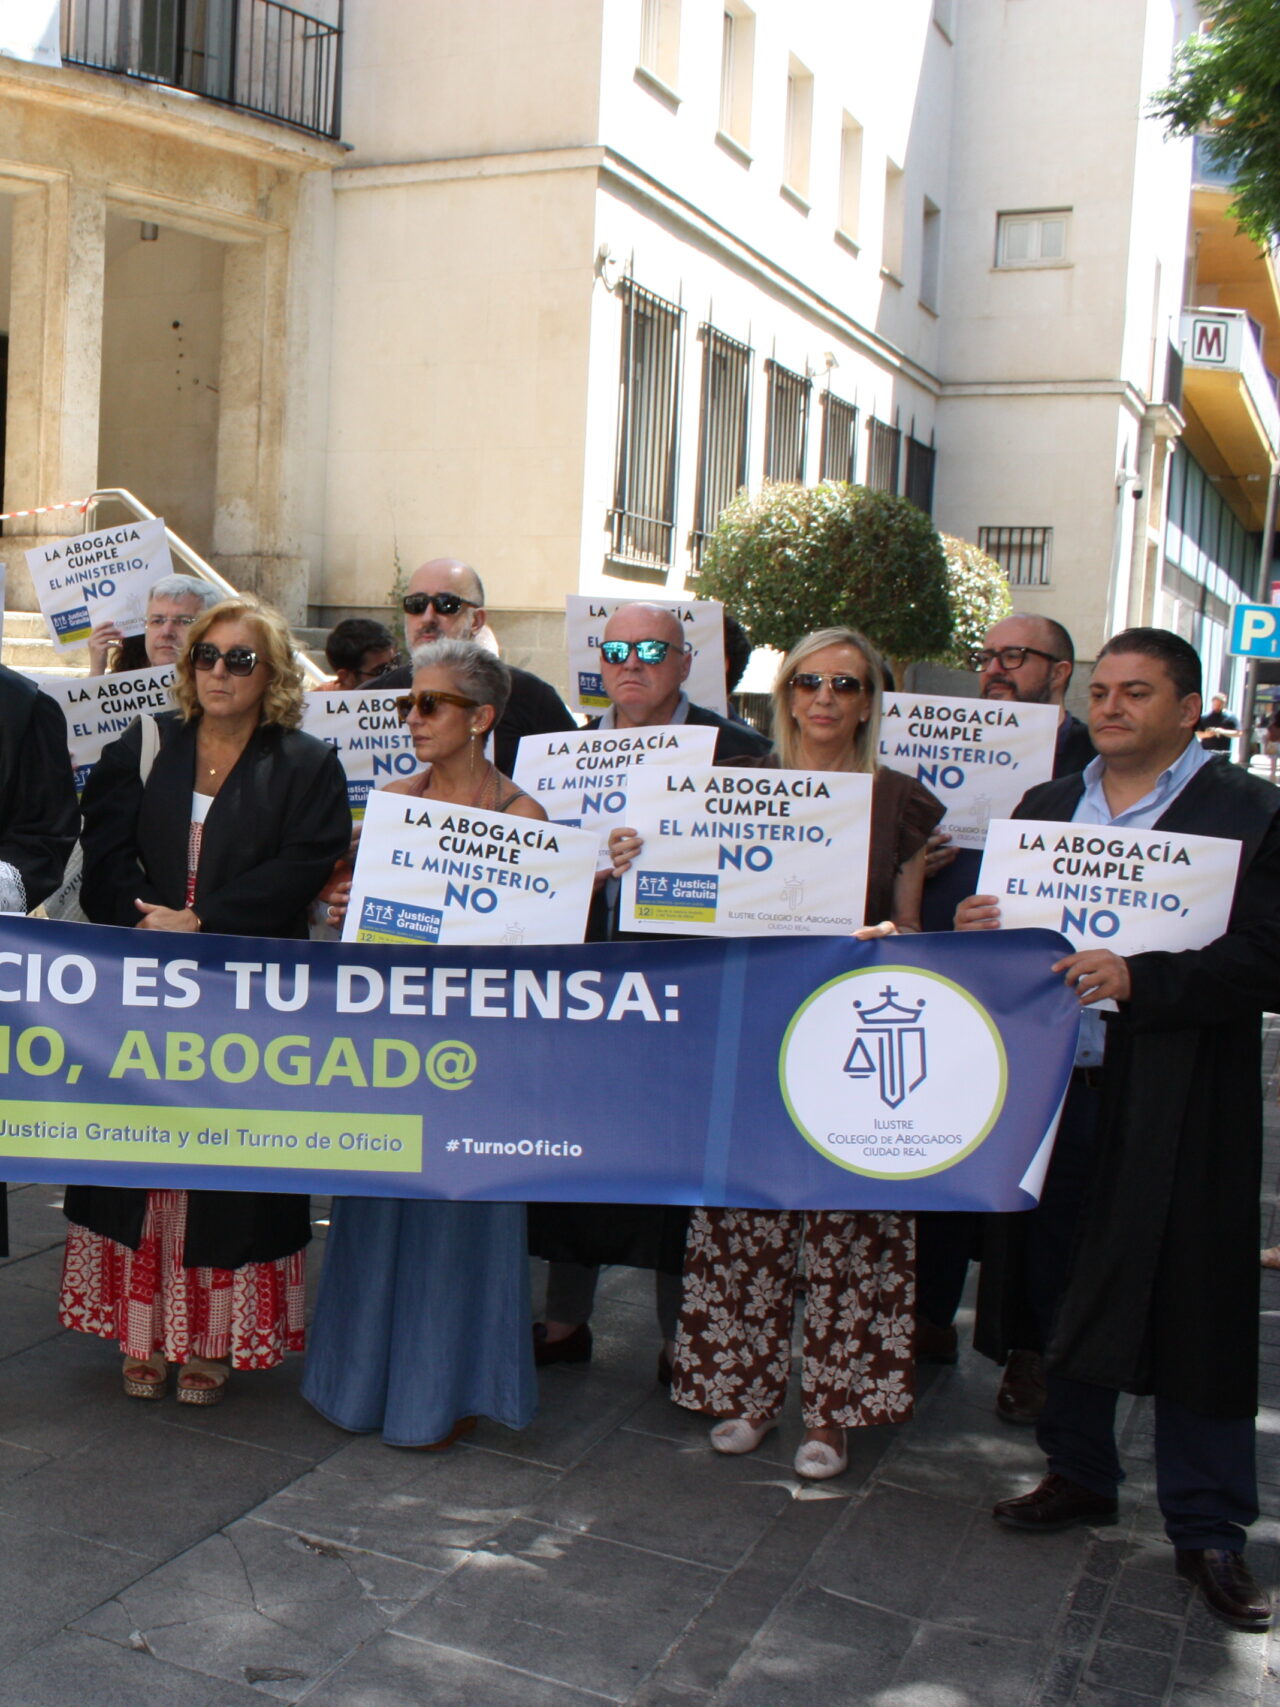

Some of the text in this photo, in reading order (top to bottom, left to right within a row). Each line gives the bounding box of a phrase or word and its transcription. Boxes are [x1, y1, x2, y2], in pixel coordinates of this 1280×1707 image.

[1196, 326, 1222, 358] M
[44, 529, 141, 562] LA ABOGACÍA
[67, 547, 119, 569] CUMPLE
[49, 558, 149, 590] EL MINISTERIO,
[82, 578, 116, 602] NO
[589, 605, 608, 618] LA
[1240, 609, 1276, 651] P
[68, 671, 175, 703] LA ABOGACÍ
[101, 693, 166, 714] CUMPLE
[326, 701, 350, 714] LA
[881, 703, 1019, 727] A ABOGACÍA
[73, 723, 92, 737] EL
[908, 723, 983, 742] CUMPLE
[547, 732, 679, 756] LA ABOGACÍA
[879, 741, 1019, 770] L MINISTERIO,
[372, 753, 417, 776] NO
[918, 763, 965, 789] NO
[537, 778, 556, 791] EL
[667, 775, 831, 799] LA ABOGACÍA
[581, 791, 626, 815] NO
[705, 798, 791, 817] CUMPLE
[404, 808, 560, 853] LA ABOGACÍA
[659, 819, 833, 847] EL MINISTERIO,
[439, 836, 520, 865] CUMPLE
[718, 844, 773, 872] NO
[1020, 833, 1191, 865] LA ABOGACÍA
[391, 850, 557, 899] EL MINISTERIO,
[1053, 858, 1144, 882] CUMPLE
[672, 878, 717, 890] Justicia
[672, 888, 716, 899] Gratuita
[443, 880, 498, 914] NO
[1006, 878, 1189, 917] EL MINISTERIO,
[396, 919, 439, 934] Gratuita
[397, 909, 440, 925] Justicia
[728, 911, 756, 920] ILUSTRE
[757, 912, 792, 922] COLEGIO
[804, 915, 853, 925] ABOGADOS
[1061, 905, 1120, 938] NO
[121, 957, 200, 1009] ES
[224, 962, 310, 1012] TU
[335, 965, 680, 1022] DEFENSA:
[109, 1030, 477, 1091] ABOGAD@
[874, 1118, 914, 1130] ILUSTRE
[85, 1122, 170, 1143] Gratuita
[178, 1130, 190, 1148] y
[197, 1127, 229, 1146] del
[236, 1128, 298, 1149] Turno
[305, 1131, 331, 1150] de
[338, 1132, 403, 1152] Oficio
[445, 1137, 583, 1158] #TurnoOficio
[827, 1133, 962, 1145] COLEGIO DE ABOGADOS
[863, 1147, 927, 1157] CIUDAD REAL
